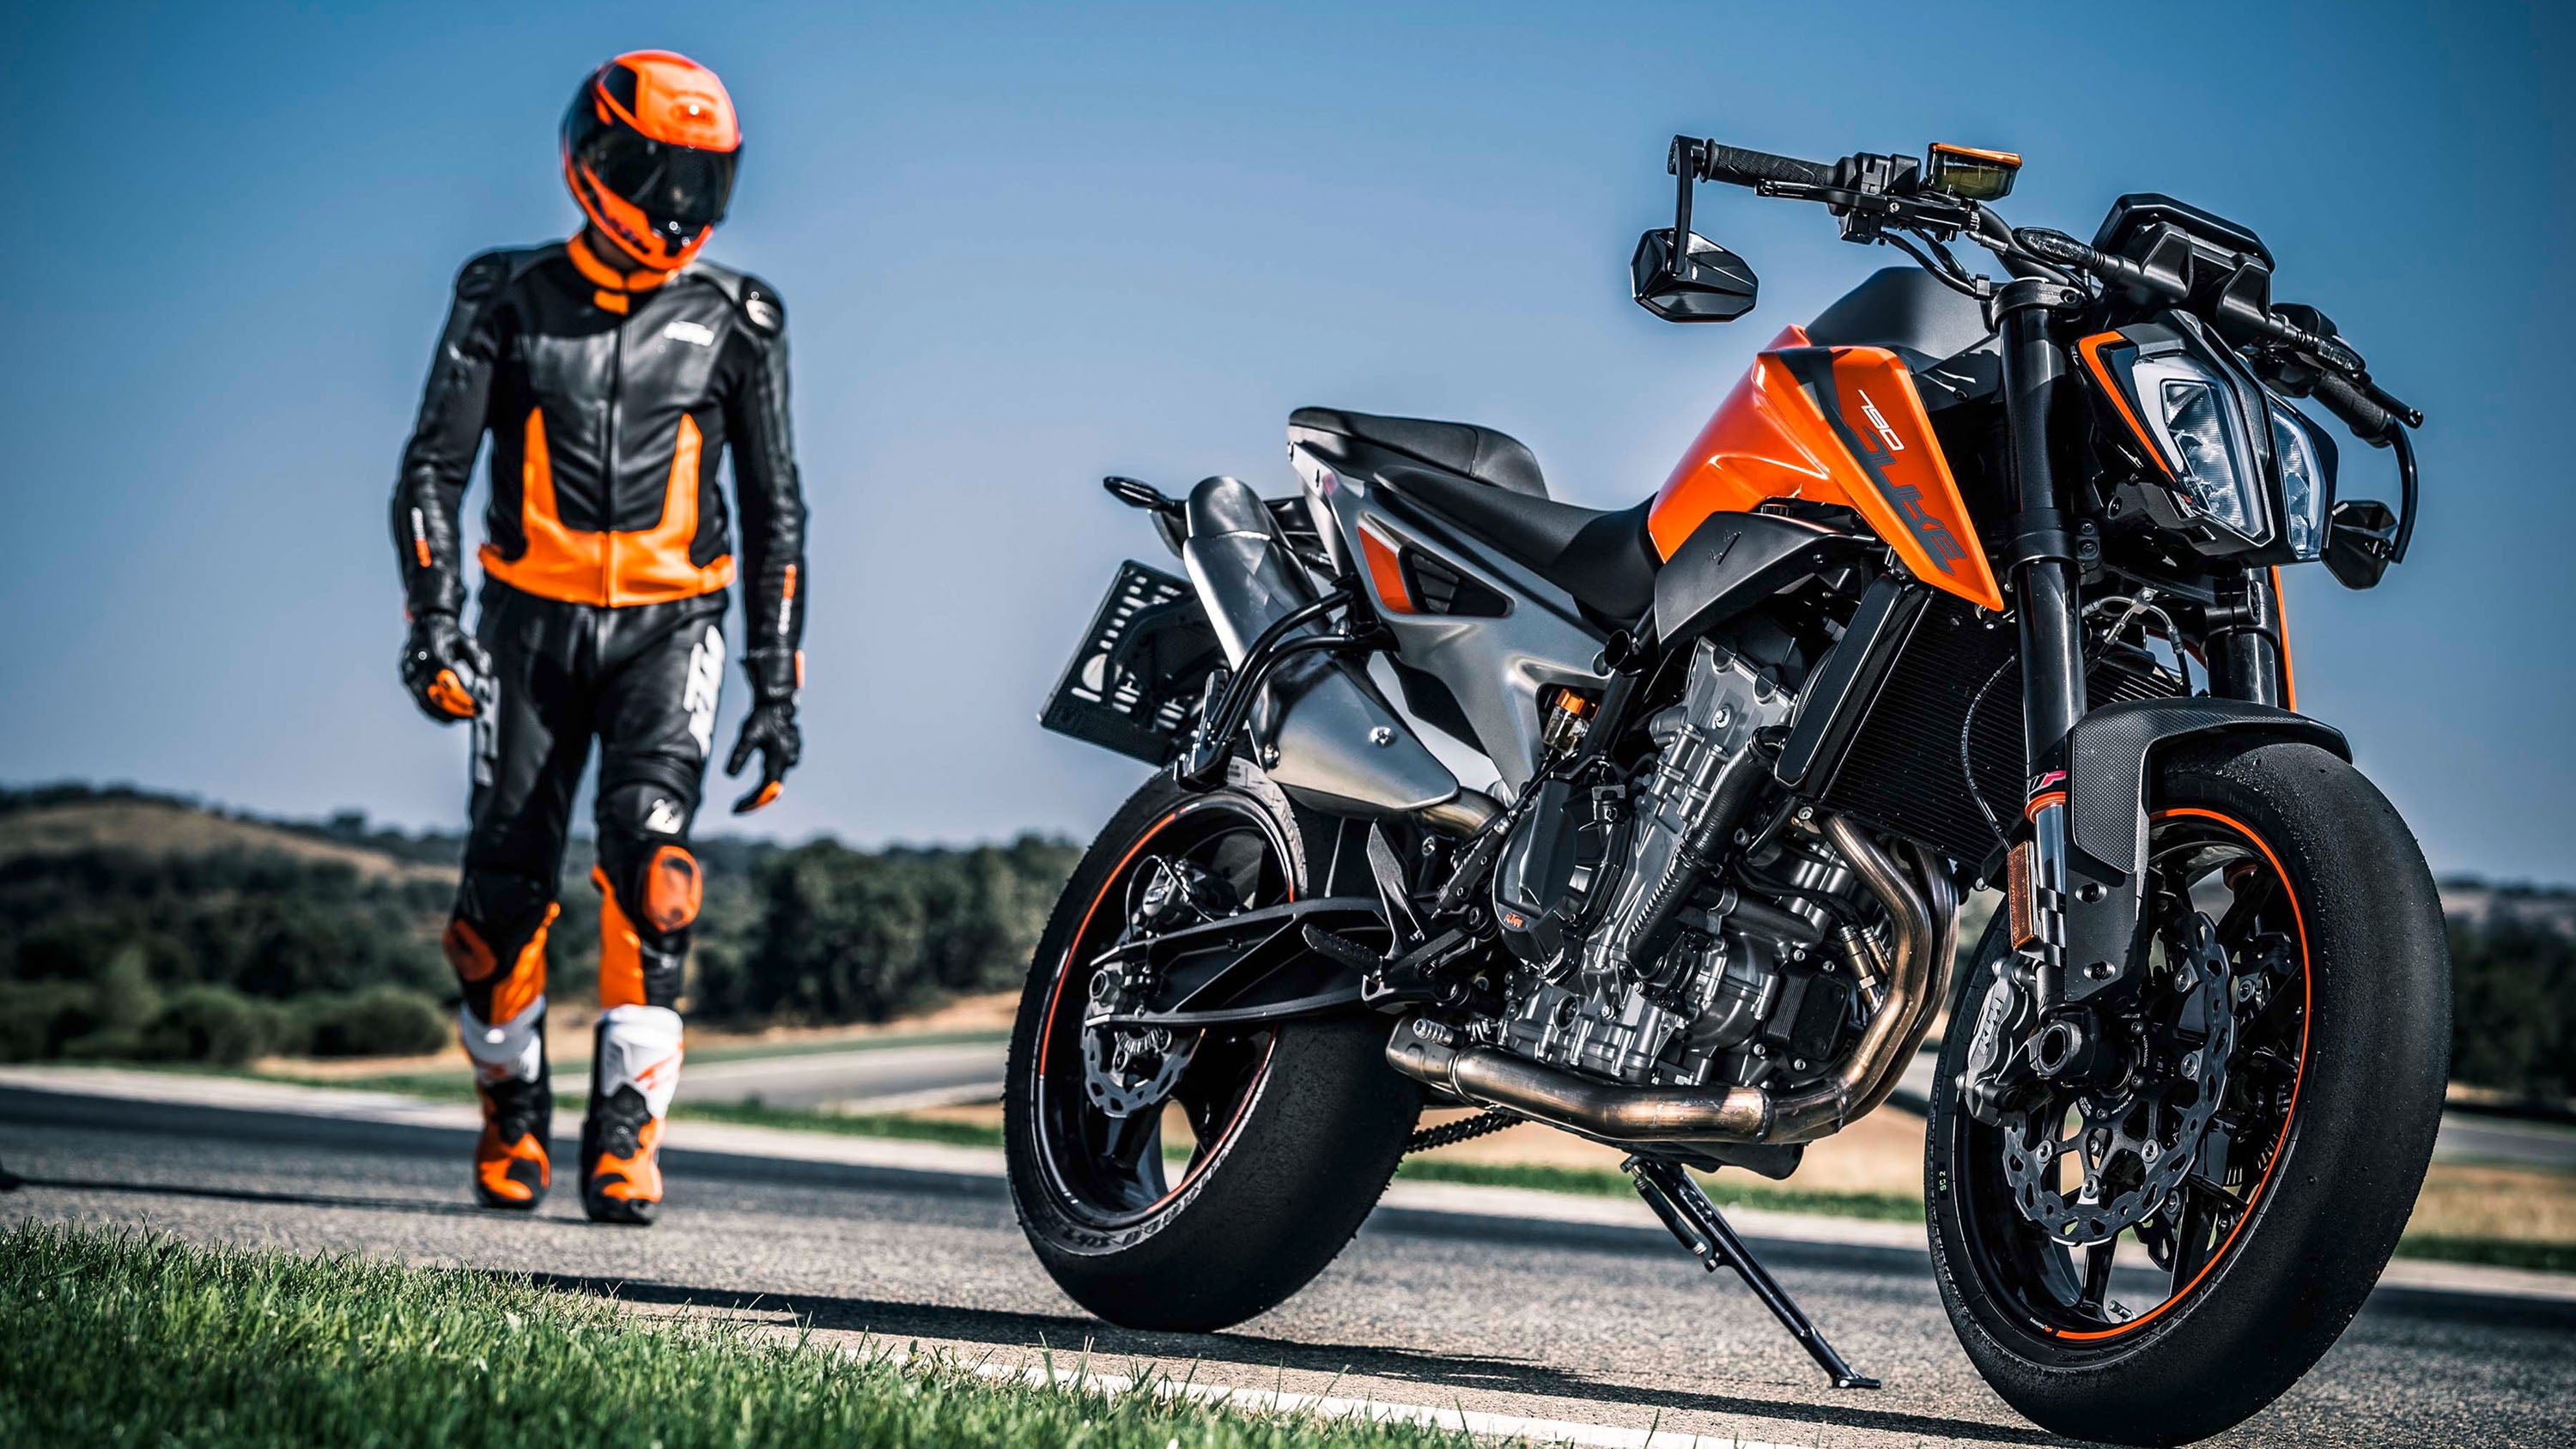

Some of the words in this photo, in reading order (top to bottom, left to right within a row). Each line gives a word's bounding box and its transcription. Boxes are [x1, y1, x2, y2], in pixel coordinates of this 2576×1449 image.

[1858, 389, 1905, 452] 790
[1852, 425, 1968, 577] DUKE
[1504, 912, 1524, 928] KTM
[1978, 997, 2005, 1057] KTM
[1939, 1179, 1947, 1191] SC
